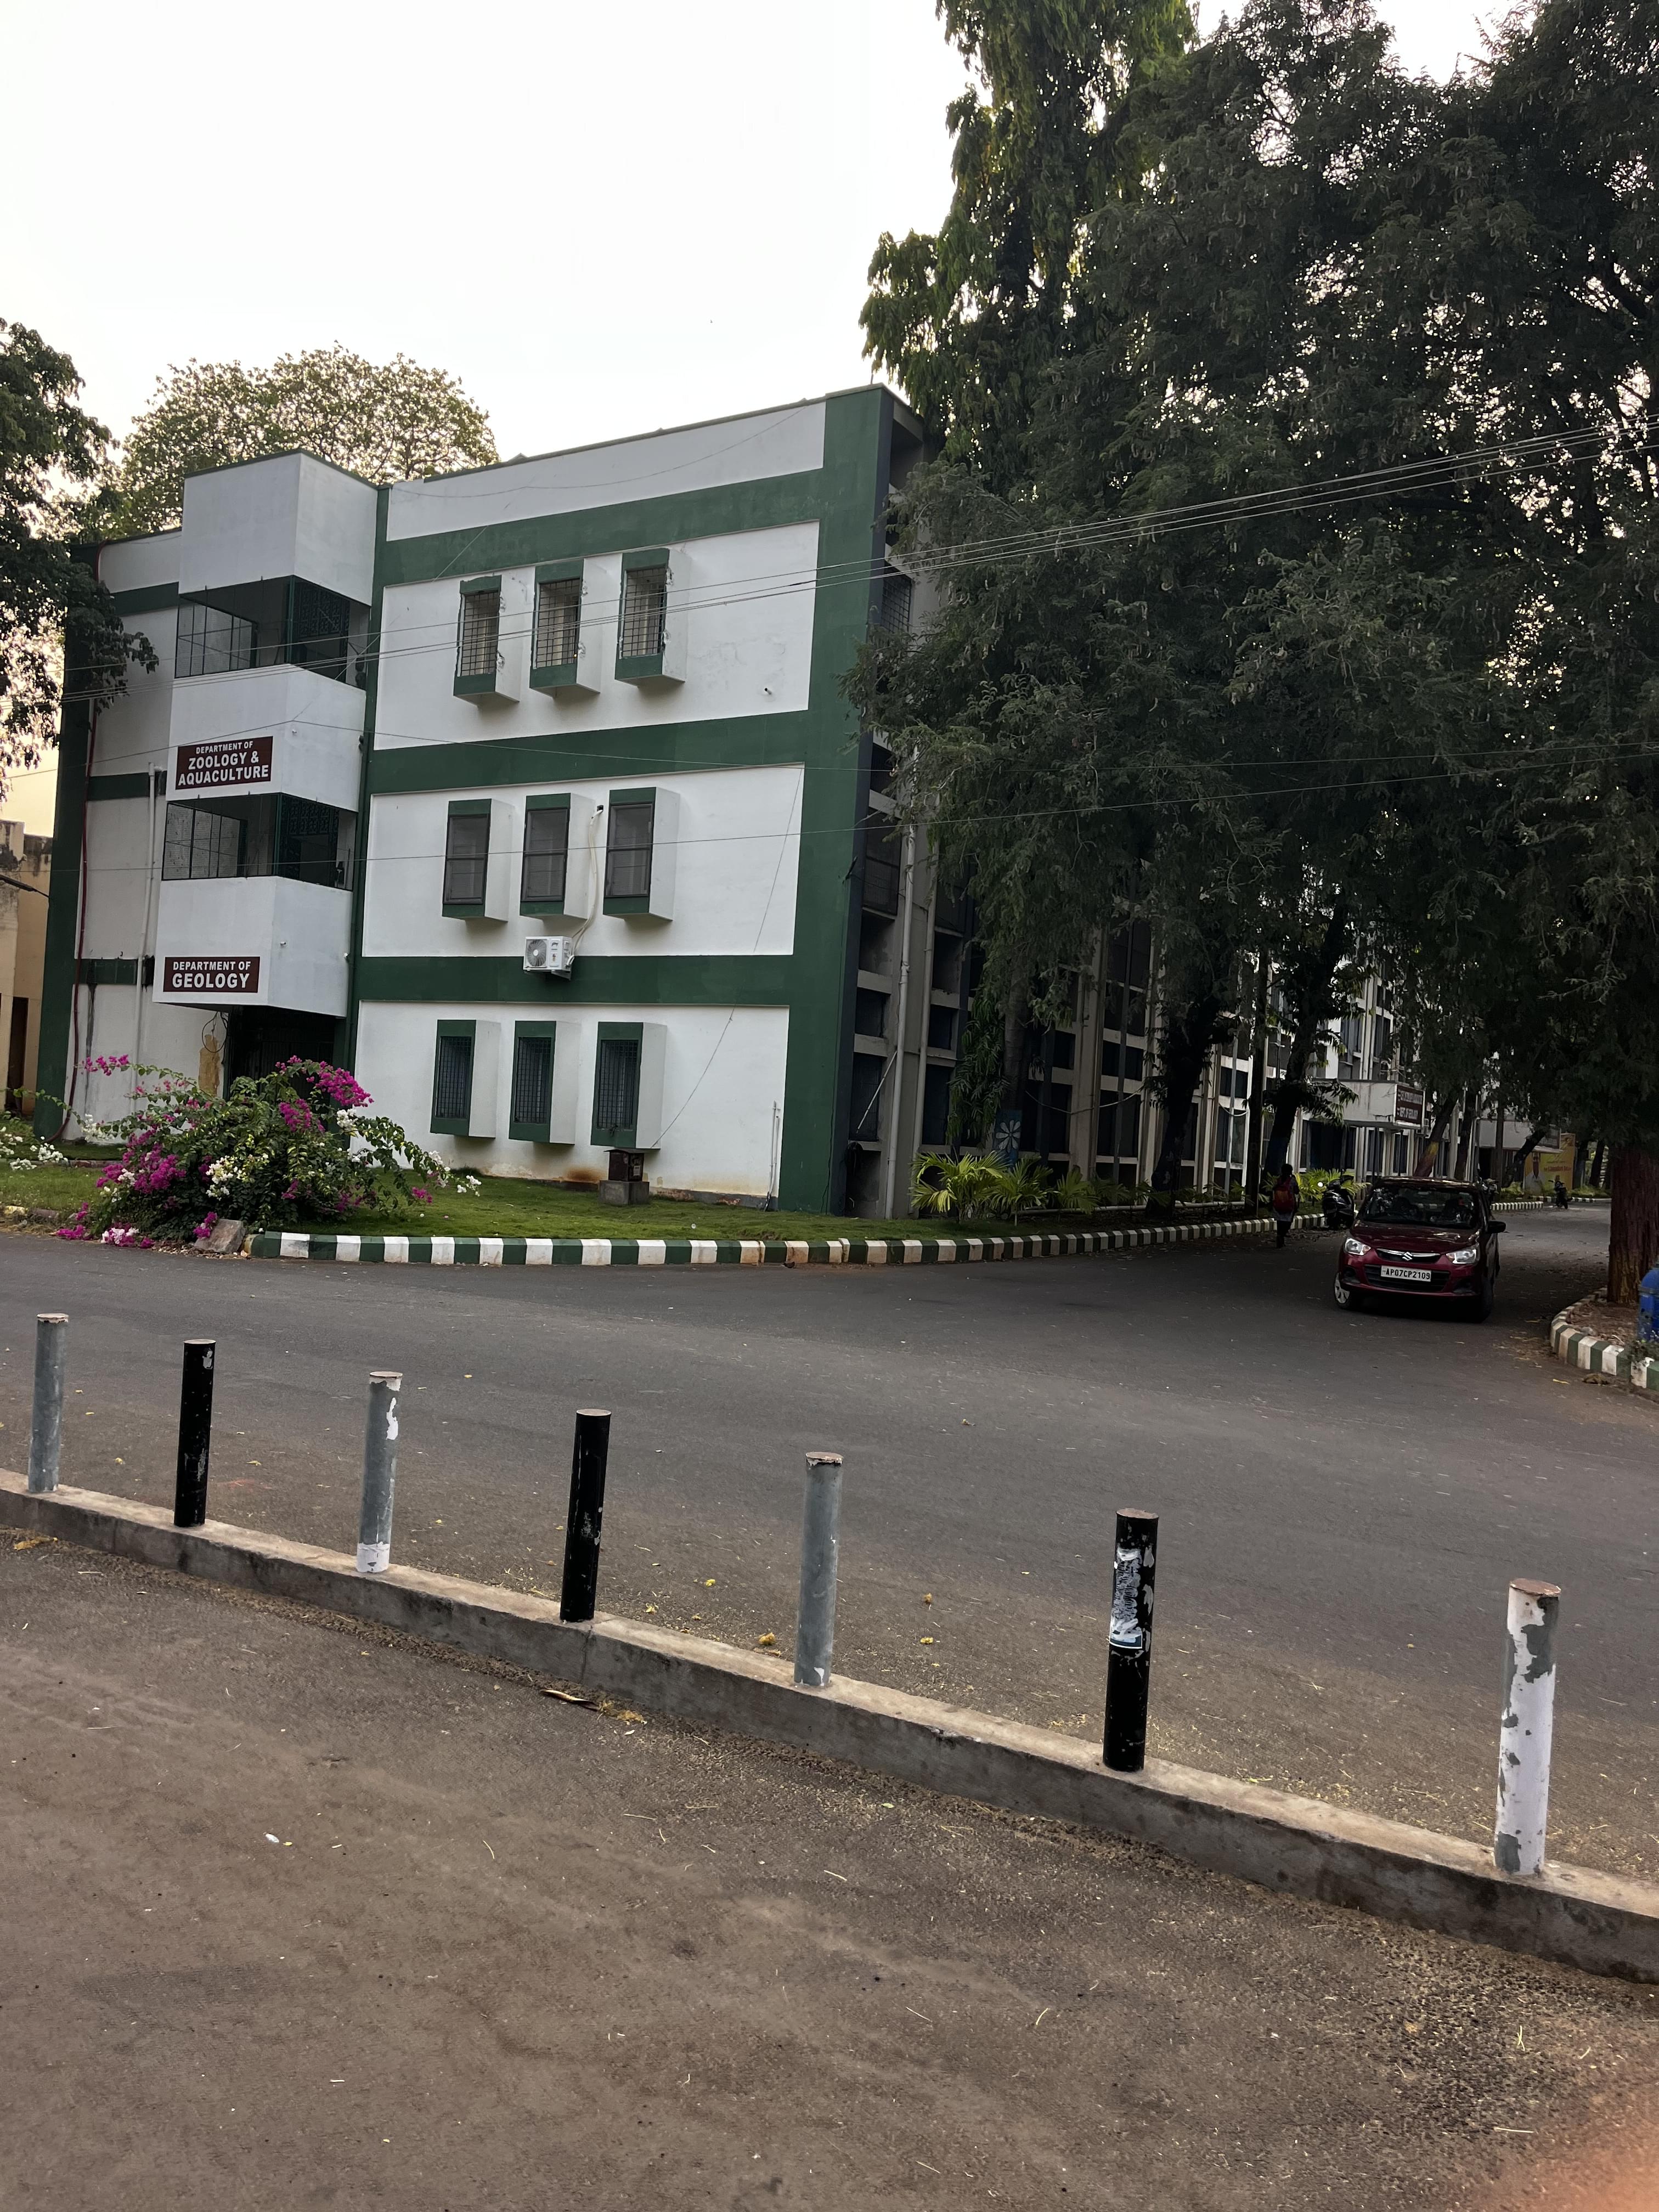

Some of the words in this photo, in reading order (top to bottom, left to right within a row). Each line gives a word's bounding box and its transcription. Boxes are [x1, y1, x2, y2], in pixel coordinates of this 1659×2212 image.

[196, 742, 242, 754] DEPARTMENT
[244, 741, 253, 749] OF
[188, 752, 247, 770] ZOOLOGY
[251, 751, 259, 764] &
[178, 764, 269, 786] AQUACULTURE
[173, 961, 236, 970] DEPARTMENT
[238, 961, 251, 970] OF
[172, 973, 250, 988] GEOLOGY
[1386, 1268, 1430, 1279] AP07CP2109
